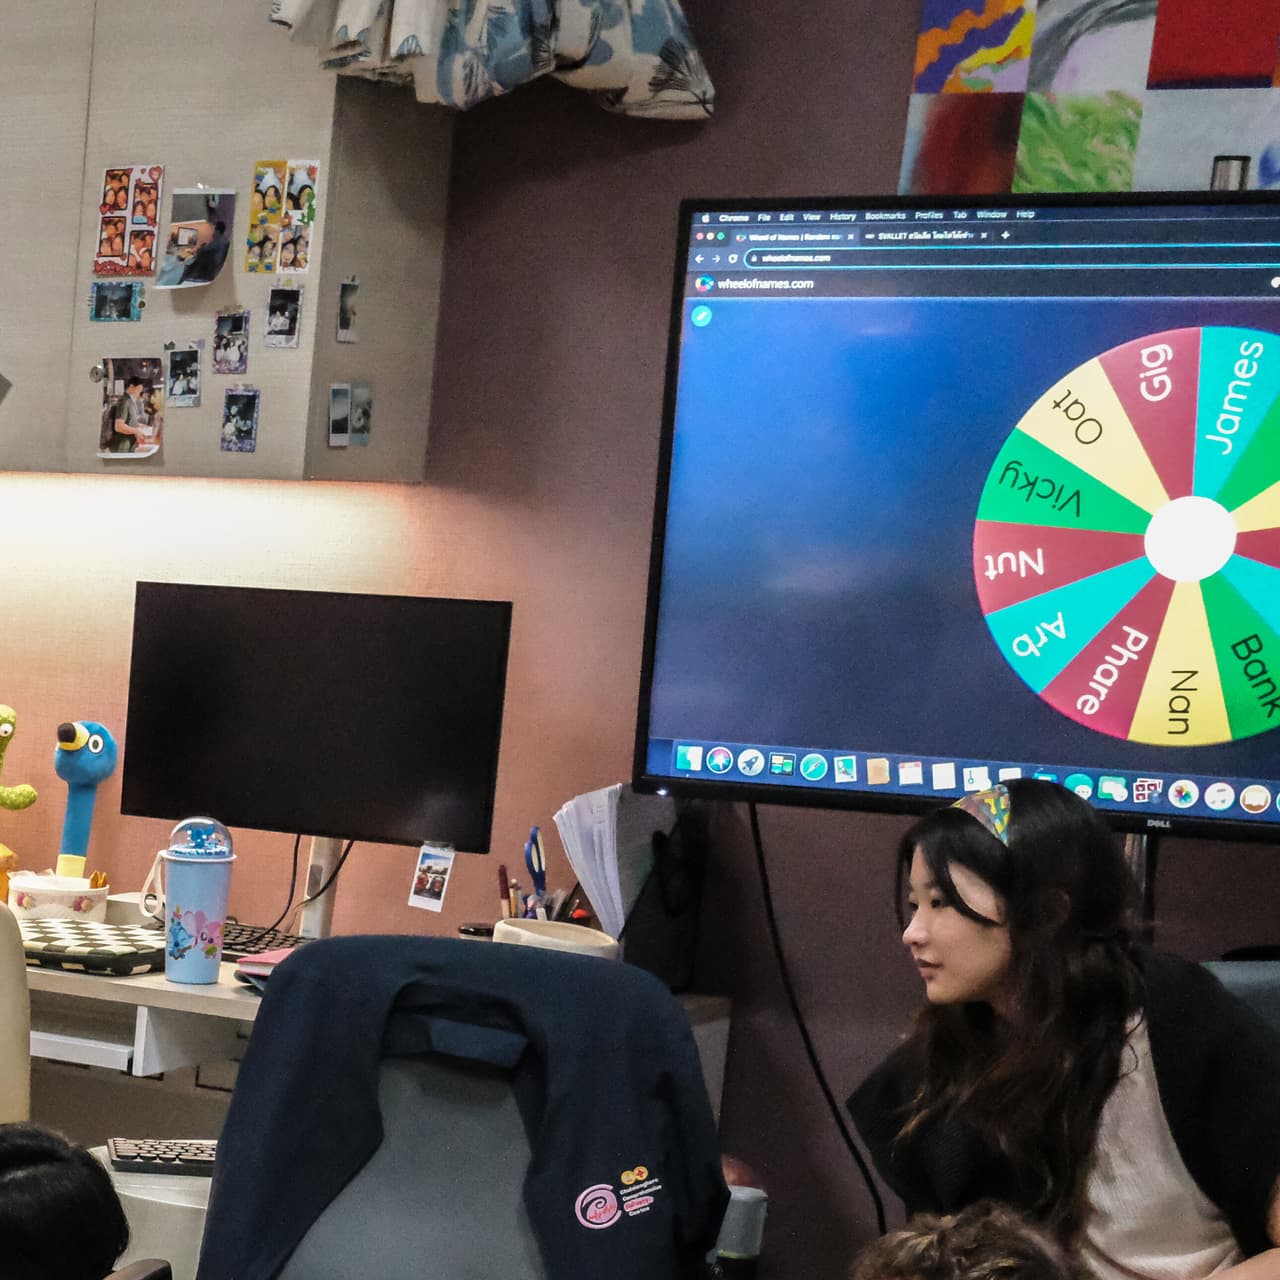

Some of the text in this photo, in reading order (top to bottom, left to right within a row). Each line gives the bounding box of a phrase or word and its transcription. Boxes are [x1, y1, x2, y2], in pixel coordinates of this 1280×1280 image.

[780, 213, 794, 221] Edit
[803, 213, 821, 221] View
[830, 212, 856, 222] History
[865, 212, 906, 220] Bookmarks
[915, 211, 943, 219] Profiles
[954, 210, 967, 219] Tab
[977, 210, 1007, 219] Window
[1016, 210, 1035, 219] Help
[718, 278, 814, 289] wheelofnames.com
[1139, 343, 1174, 402] Gig
[1205, 341, 1264, 455] James
[1051, 389, 1103, 445] Oat
[999, 460, 1081, 518] Vicky
[984, 548, 1045, 581] Nut
[1012, 612, 1067, 657] Arb
[1076, 625, 1149, 715] Phare
[1231, 633, 1280, 719] Bank
[1167, 670, 1199, 735] Nan
[1146, 819, 1171, 828] DELL
